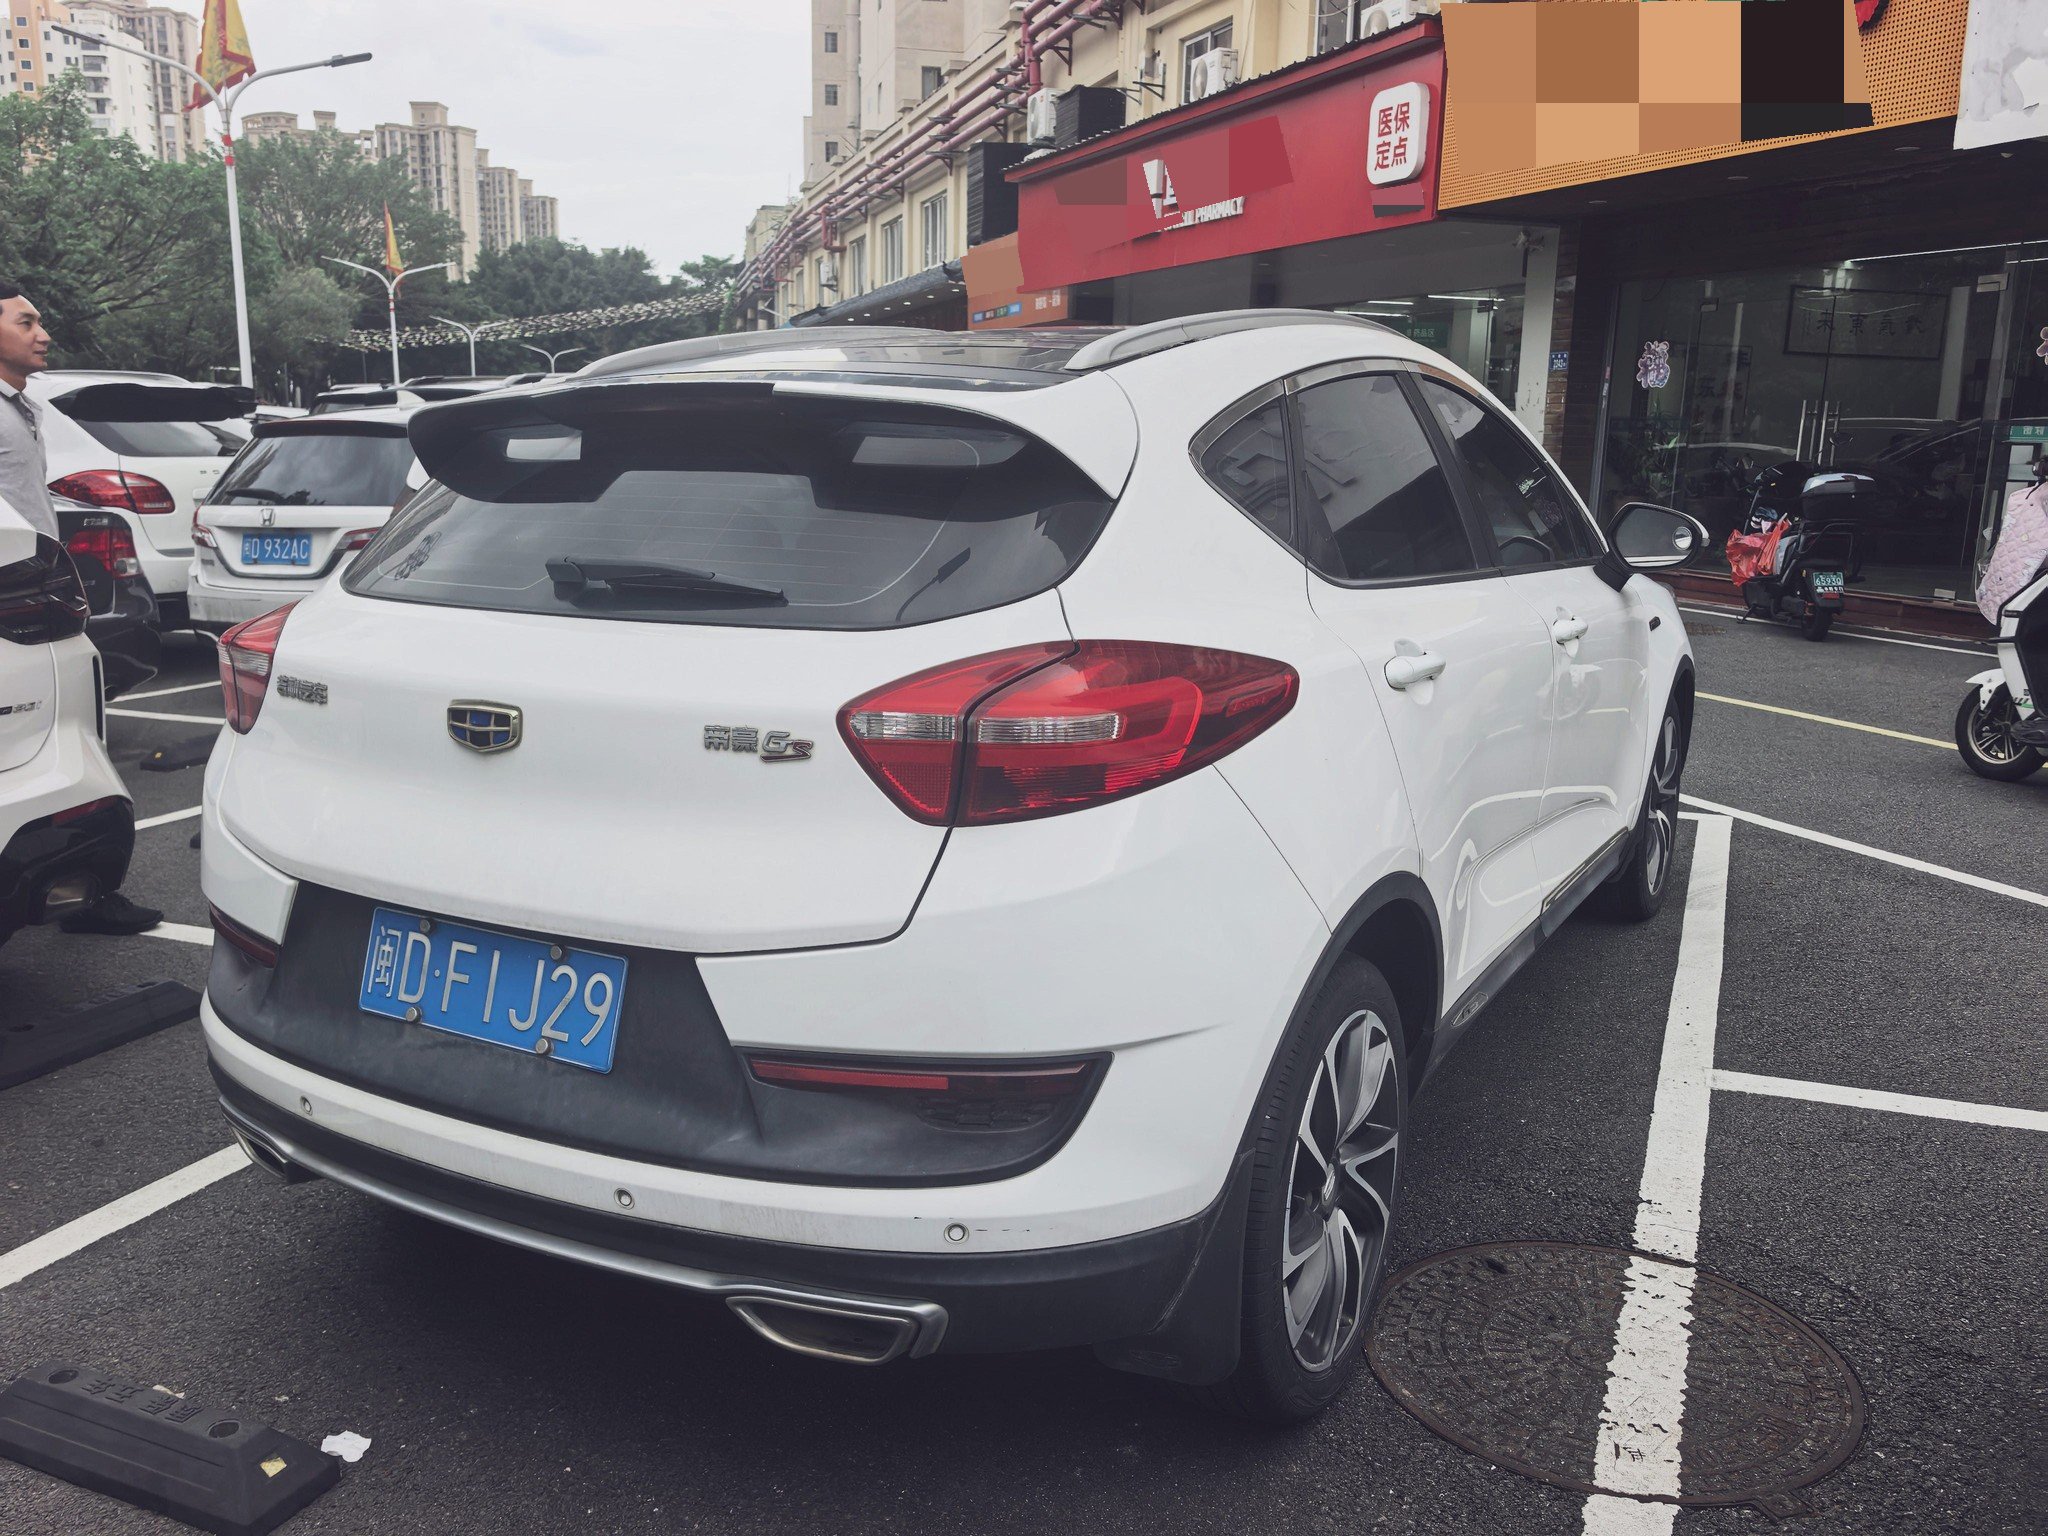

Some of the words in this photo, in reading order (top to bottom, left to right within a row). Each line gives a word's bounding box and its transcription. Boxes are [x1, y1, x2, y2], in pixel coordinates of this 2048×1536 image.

[1378, 102, 1410, 137] 医保
[1374, 136, 1408, 171] 定点
[1195, 196, 1246, 225] PHARMACY
